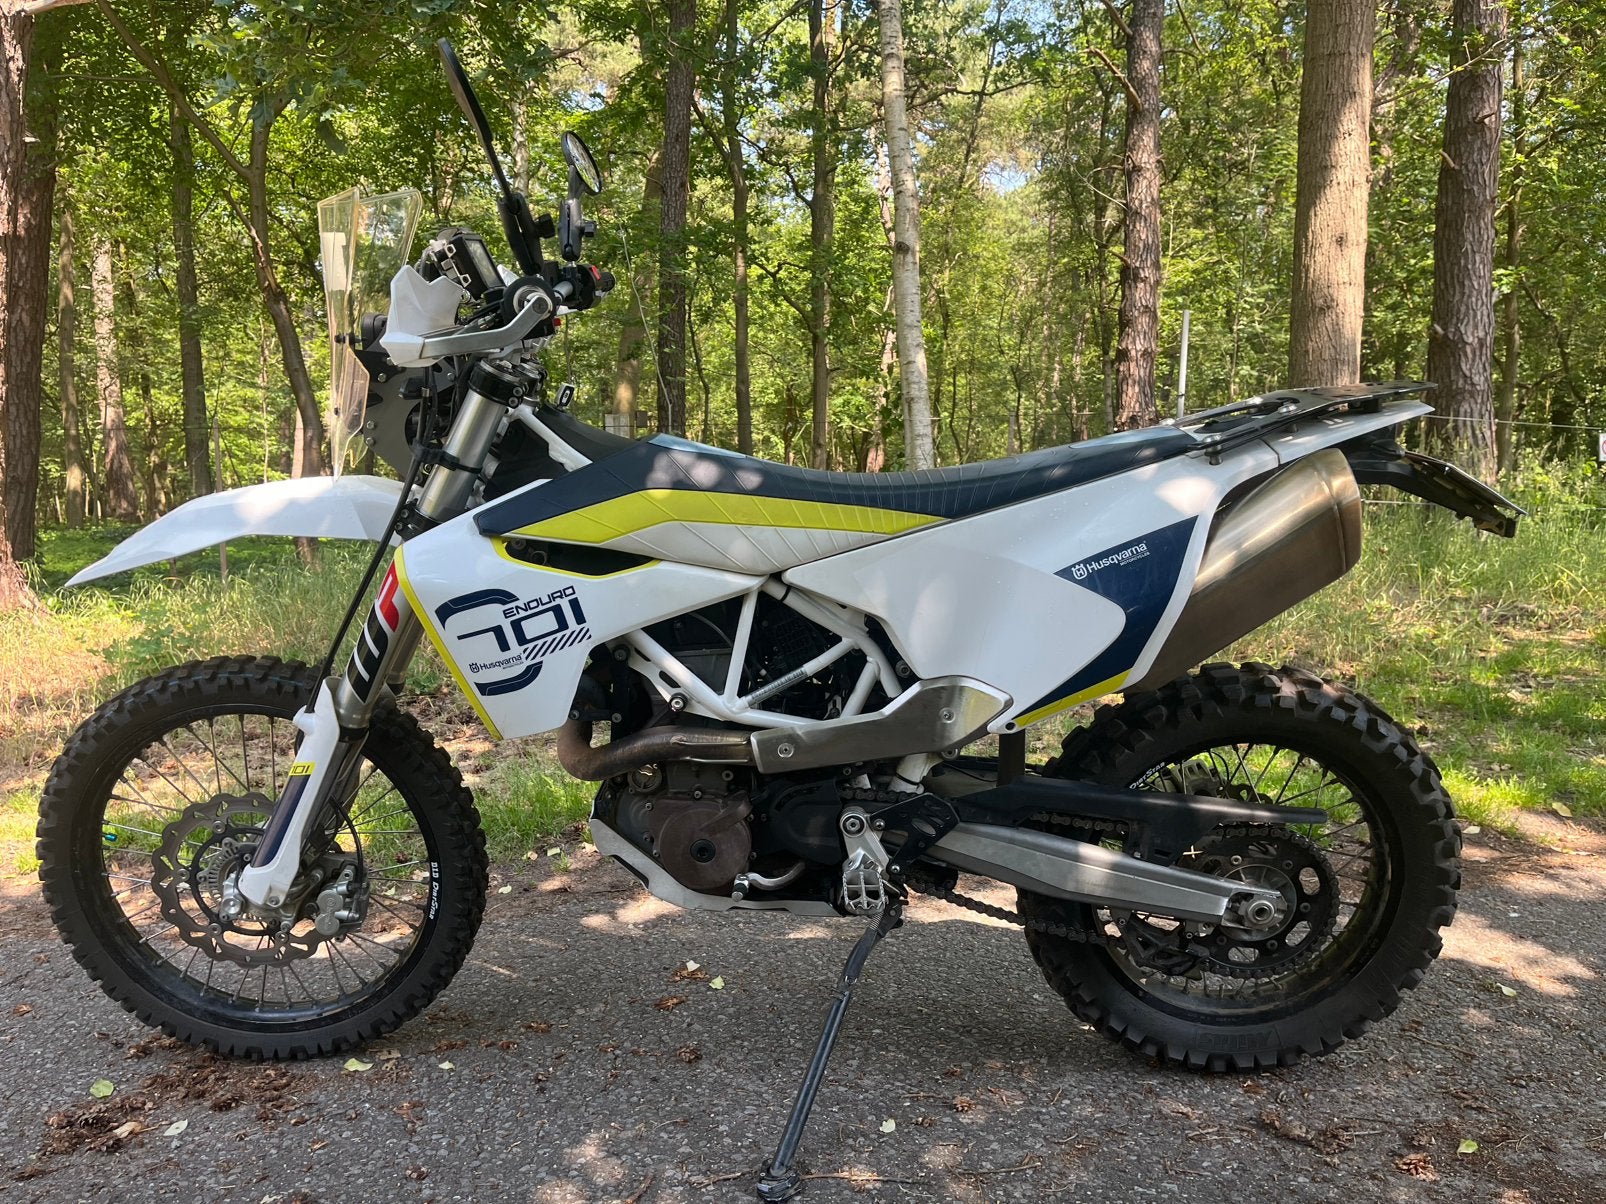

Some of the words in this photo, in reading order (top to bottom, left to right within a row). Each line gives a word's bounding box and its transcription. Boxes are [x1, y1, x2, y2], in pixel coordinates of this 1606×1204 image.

[1087, 542, 1148, 574] Husqvarna
[503, 585, 576, 618] ENDURO
[457, 597, 586, 653] 701
[480, 655, 523, 672] Husqvarna
